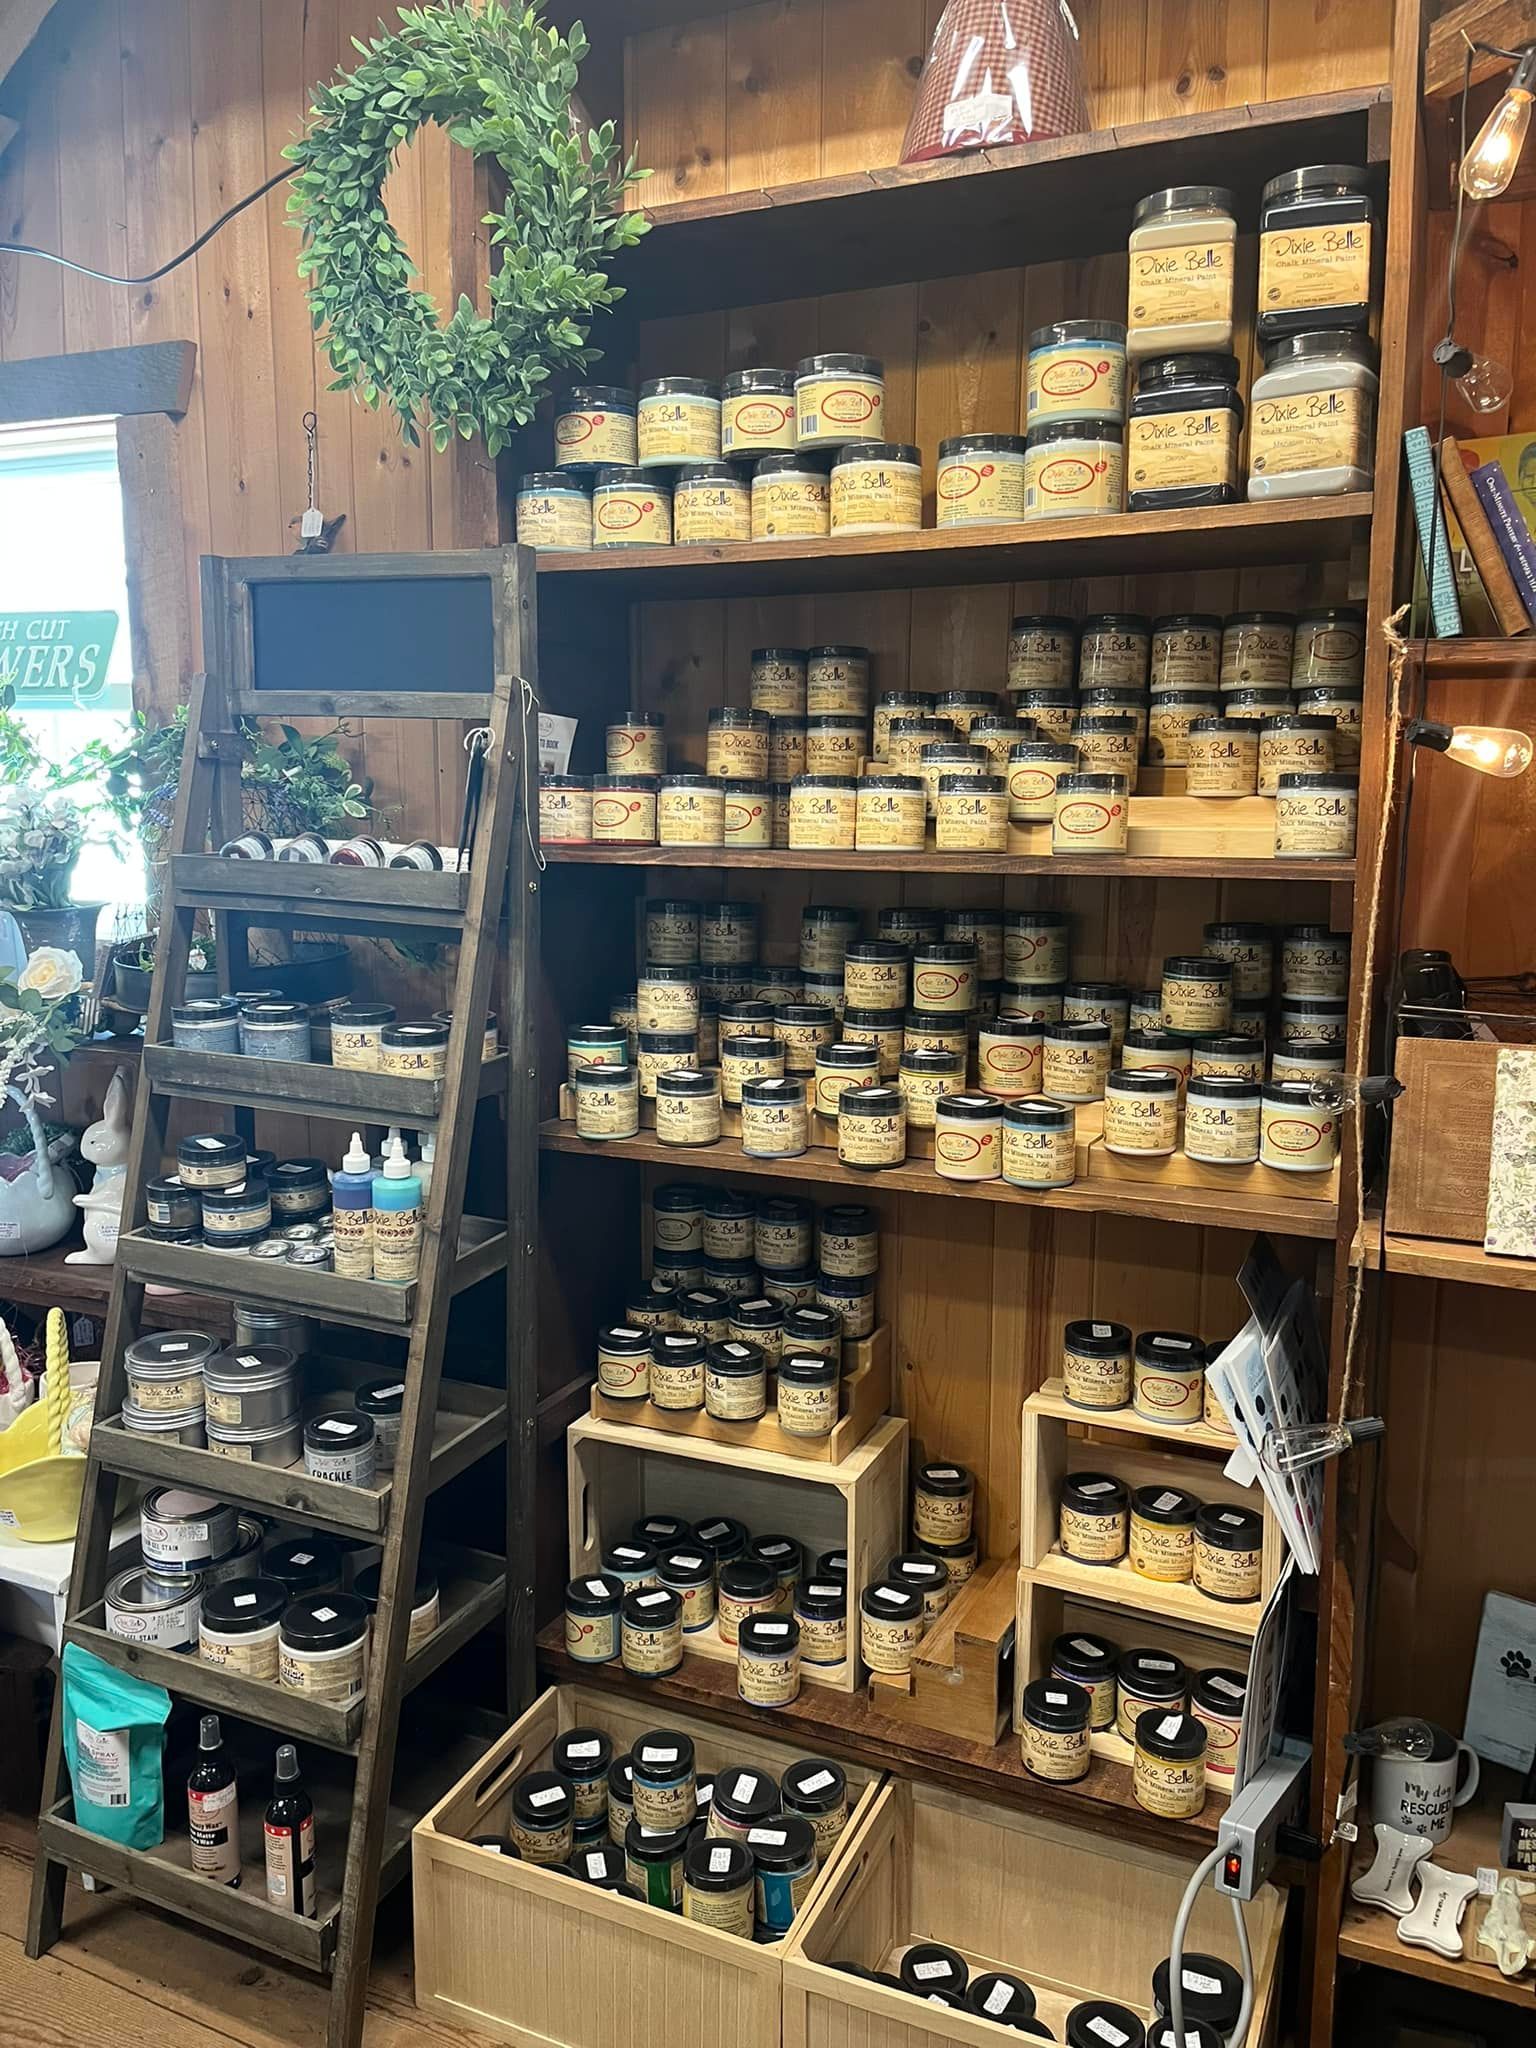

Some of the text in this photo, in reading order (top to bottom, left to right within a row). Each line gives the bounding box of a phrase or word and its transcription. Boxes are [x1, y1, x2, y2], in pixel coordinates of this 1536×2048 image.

[1271, 229, 1364, 258] Dixie Belle
[1136, 249, 1224, 277] Dixie Belle
[1275, 253, 1357, 268] Chalk Mineral Paint
[1140, 272, 1217, 287] Chalk Mineral Paint
[658, 405, 689, 423] Belle
[1260, 393, 1346, 425] Dixie Belle
[1136, 416, 1221, 441] Dixie Belle
[1261, 419, 1340, 436] Chalk Mineral Paint
[1141, 437, 1215, 453] Chalk Mineral Paint
[861, 471, 893, 490] Belle
[702, 490, 732, 506] Belle
[768, 485, 801, 502] Dixie
[530, 499, 556, 515] Belle
[26, 619, 71, 641] CUT
[1036, 637, 1061, 653] Belle
[1109, 635, 1136, 652] Belle
[1184, 635, 1211, 651] Belle
[1244, 633, 1279, 651] Dixie
[770, 667, 796, 682] Belle
[819, 666, 846, 682] Belle
[1160, 713, 1189, 729] Dixie
[1332, 708, 1361, 725] Belle
[722, 732, 751, 747] Dixie
[778, 737, 802, 751] Belle
[830, 736, 856, 751] Belle
[1075, 736, 1135, 752] Dixie Belle
[1263, 738, 1325, 757] Dixie Belle
[1210, 742, 1241, 759] Belle
[547, 794, 573, 810] Belle
[674, 795, 701, 812] Belle
[809, 798, 838, 814] Belle
[872, 796, 900, 813] Belle
[957, 799, 988, 816] Belle
[1280, 798, 1347, 817] Dixie Belle
[1297, 819, 1346, 827] Mineral Paint
[713, 922, 738, 936] Belle
[1230, 947, 1260, 963] Belle
[1286, 950, 1344, 965] Dixie Belle
[846, 965, 897, 981] Dixie Belle
[651, 987, 680, 1001] Dixie
[1168, 981, 1228, 998] Dixie Belle
[796, 1028, 824, 1043] Belle
[1286, 1024, 1312, 1039] Dixie
[345, 1033, 374, 1049] Belle
[401, 1053, 430, 1070] Belle
[645, 1054, 669, 1069] Dixie
[1066, 1050, 1095, 1065] Belle
[739, 1060, 766, 1076] Belle
[923, 1080, 950, 1096] Belle
[589, 1091, 617, 1106] Belle
[662, 1099, 690, 1114] Belle
[1104, 1097, 1162, 1117] Dixie Belle
[761, 1108, 791, 1124] Belle
[1144, 1120, 1161, 1128] Paint
[1203, 1107, 1234, 1125] Belle
[840, 1115, 898, 1134] Dixie Belle
[1023, 1132, 1053, 1149] Belle
[1215, 1129, 1233, 1137] Paint
[345, 1210, 374, 1226] Belle
[721, 1221, 745, 1234] Belle
[771, 1227, 797, 1240] Belle
[831, 1237, 856, 1251] Belle
[690, 1322, 714, 1335] Belle
[1067, 1354, 1123, 1376] Dixie Belle
[680, 1366, 702, 1381] Belle
[779, 1385, 830, 1405] Dixie Belle
[312, 1470, 352, 1483] CRACKLE
[918, 1496, 968, 1516] Dixie Belle
[1065, 1510, 1121, 1532] Dixie Belle
[1142, 1529, 1170, 1548] Dixie
[162, 1543, 179, 1552] STAIN
[1198, 1544, 1259, 1568] Dixie Belle
[824, 1620, 847, 1636] Belle
[139, 1633, 158, 1642] STAIN
[635, 1632, 661, 1646] Belle
[888, 1629, 914, 1644] Belle
[741, 1655, 793, 1676] Dixie Belle
[1030, 1726, 1088, 1751] Dixie Belle
[1165, 1768, 1195, 1786] Belle
[633, 1787, 685, 1803] Dixie Belle
[1405, 1781, 1430, 1801] My
[1400, 1800, 1451, 1816] RESCUED
[810, 1817, 836, 1834] Dixie
[1431, 1816, 1446, 1831] ME
[516, 1827, 545, 1847] Dixie
